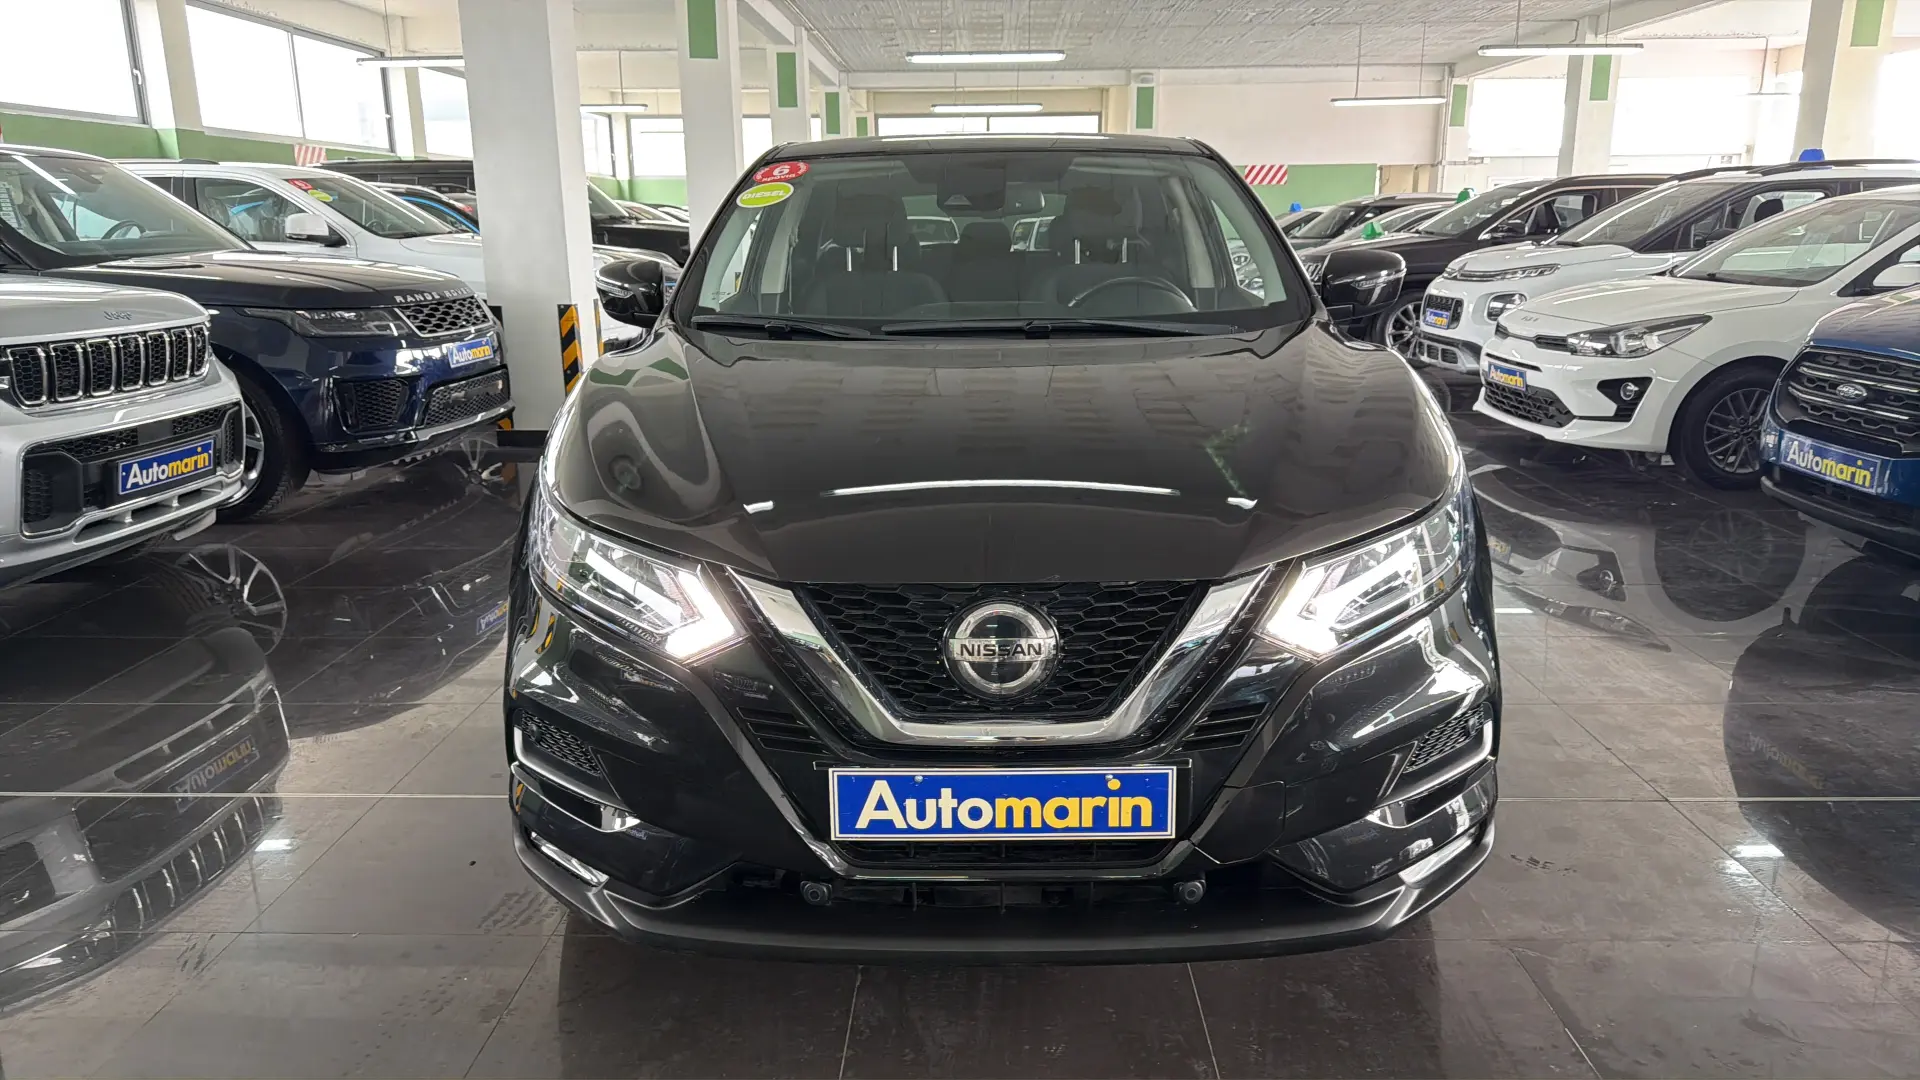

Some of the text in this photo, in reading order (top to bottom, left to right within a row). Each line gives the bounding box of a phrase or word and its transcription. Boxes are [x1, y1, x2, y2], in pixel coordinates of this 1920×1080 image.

[772, 164, 791, 176] 6
[742, 190, 786, 200] DIESEL
[452, 340, 492, 363] Automarin
[1489, 364, 1524, 387] Automarin
[125, 447, 209, 489] Automarin
[1787, 440, 1871, 487] Automarin
[959, 642, 1043, 657] NISSAN
[855, 778, 1153, 829] Automarin
